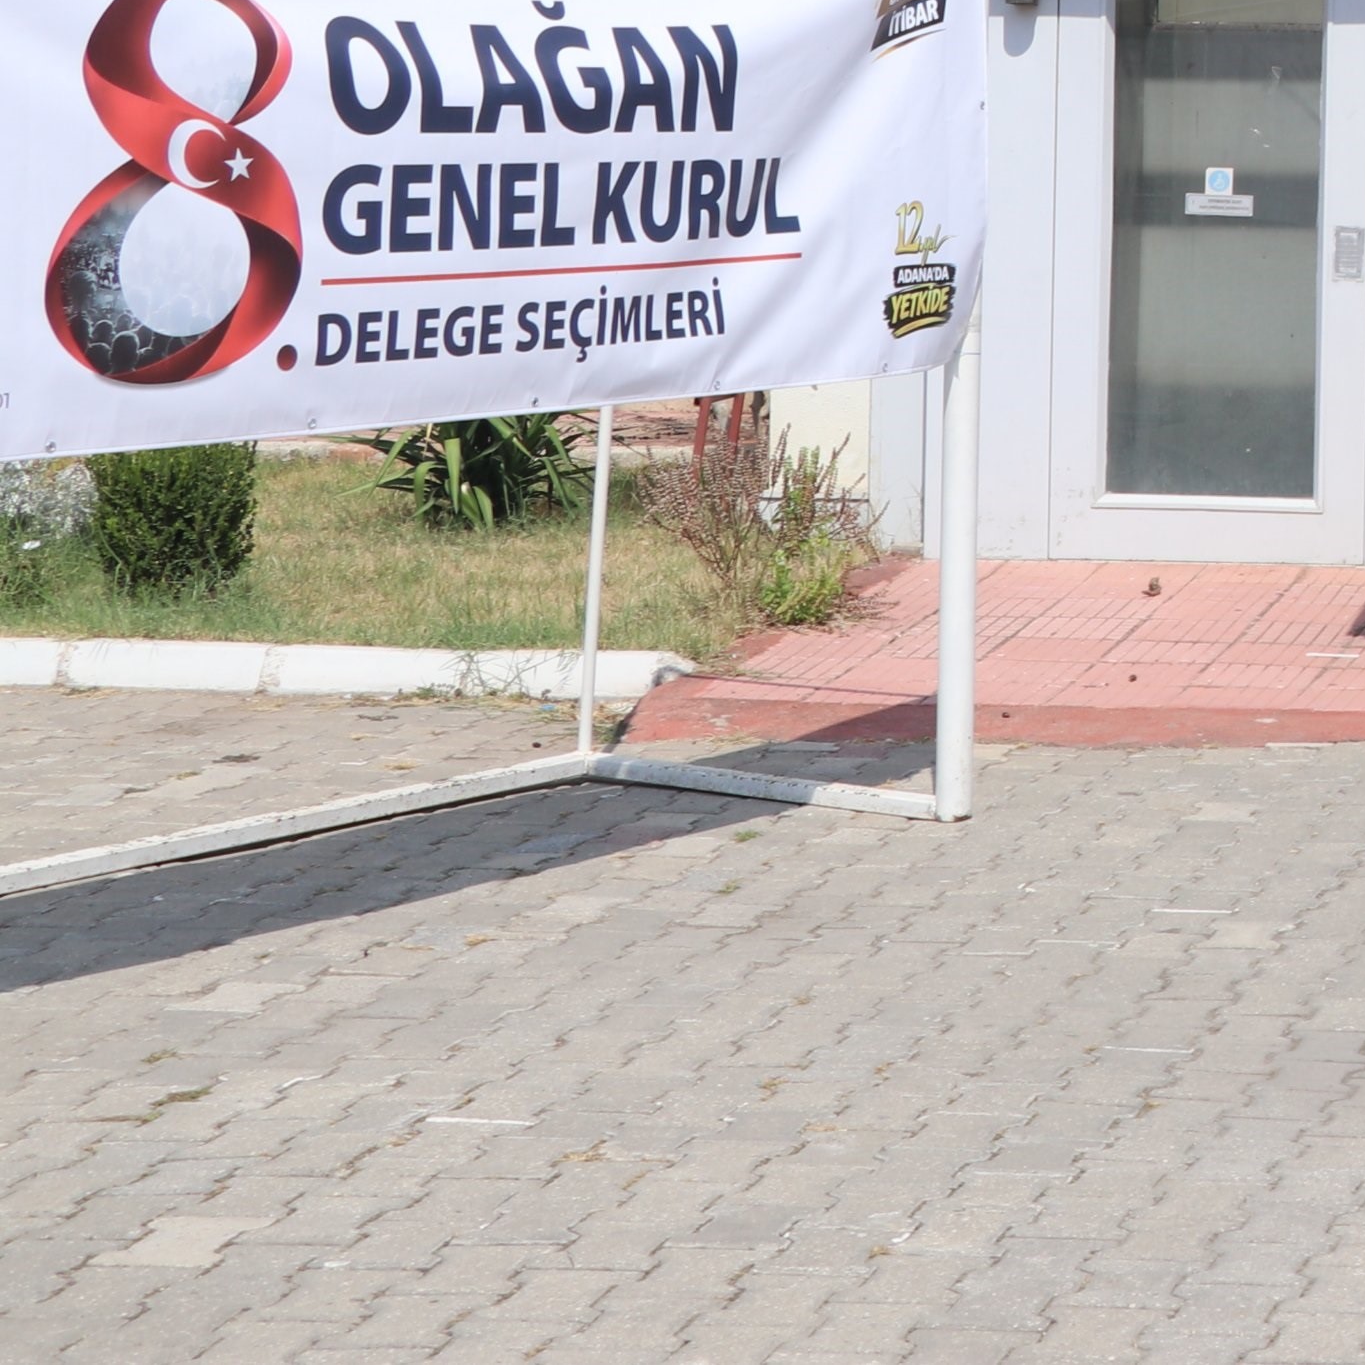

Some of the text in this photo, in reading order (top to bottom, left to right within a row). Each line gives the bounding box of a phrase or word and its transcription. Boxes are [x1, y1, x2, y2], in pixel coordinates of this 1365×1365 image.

[324, 0, 738, 136] OLAĞAN
[321, 157, 802, 255] GENEL KURUL
[891, 286, 951, 325] YETKİDE
[897, 266, 950, 284] ADANA'DA
[314, 277, 726, 366] DELEGE SEÇİMLERİ
